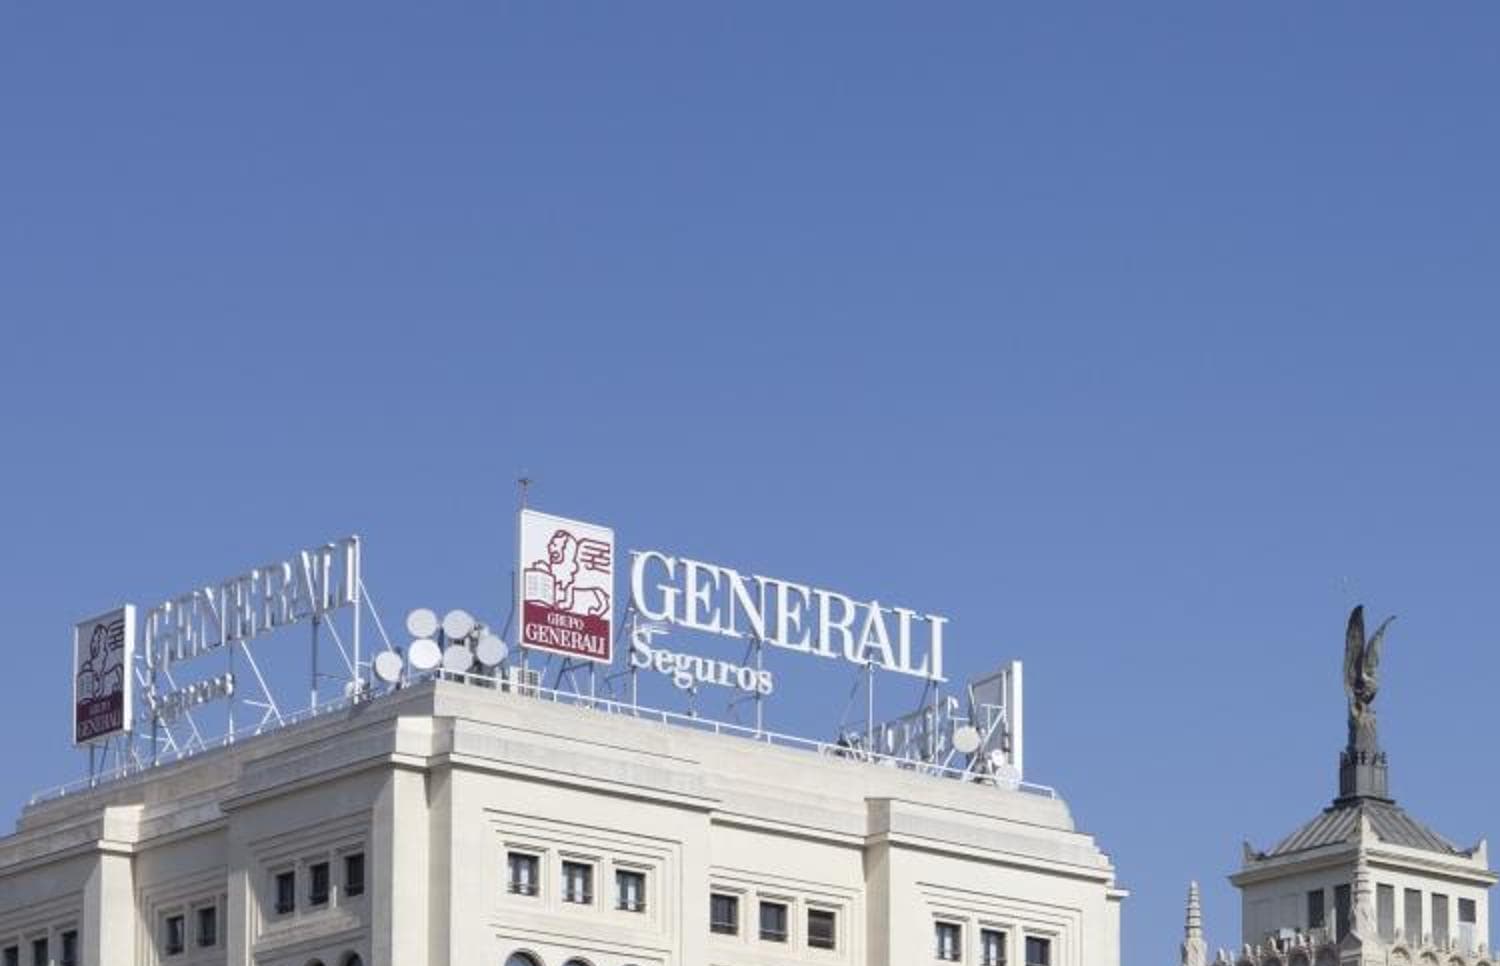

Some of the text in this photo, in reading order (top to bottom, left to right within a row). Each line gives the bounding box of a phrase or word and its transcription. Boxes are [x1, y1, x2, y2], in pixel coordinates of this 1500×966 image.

[525, 623, 605, 655] GENERALI
[631, 550, 949, 683] GENERALI
[631, 624, 774, 695] Seguros
